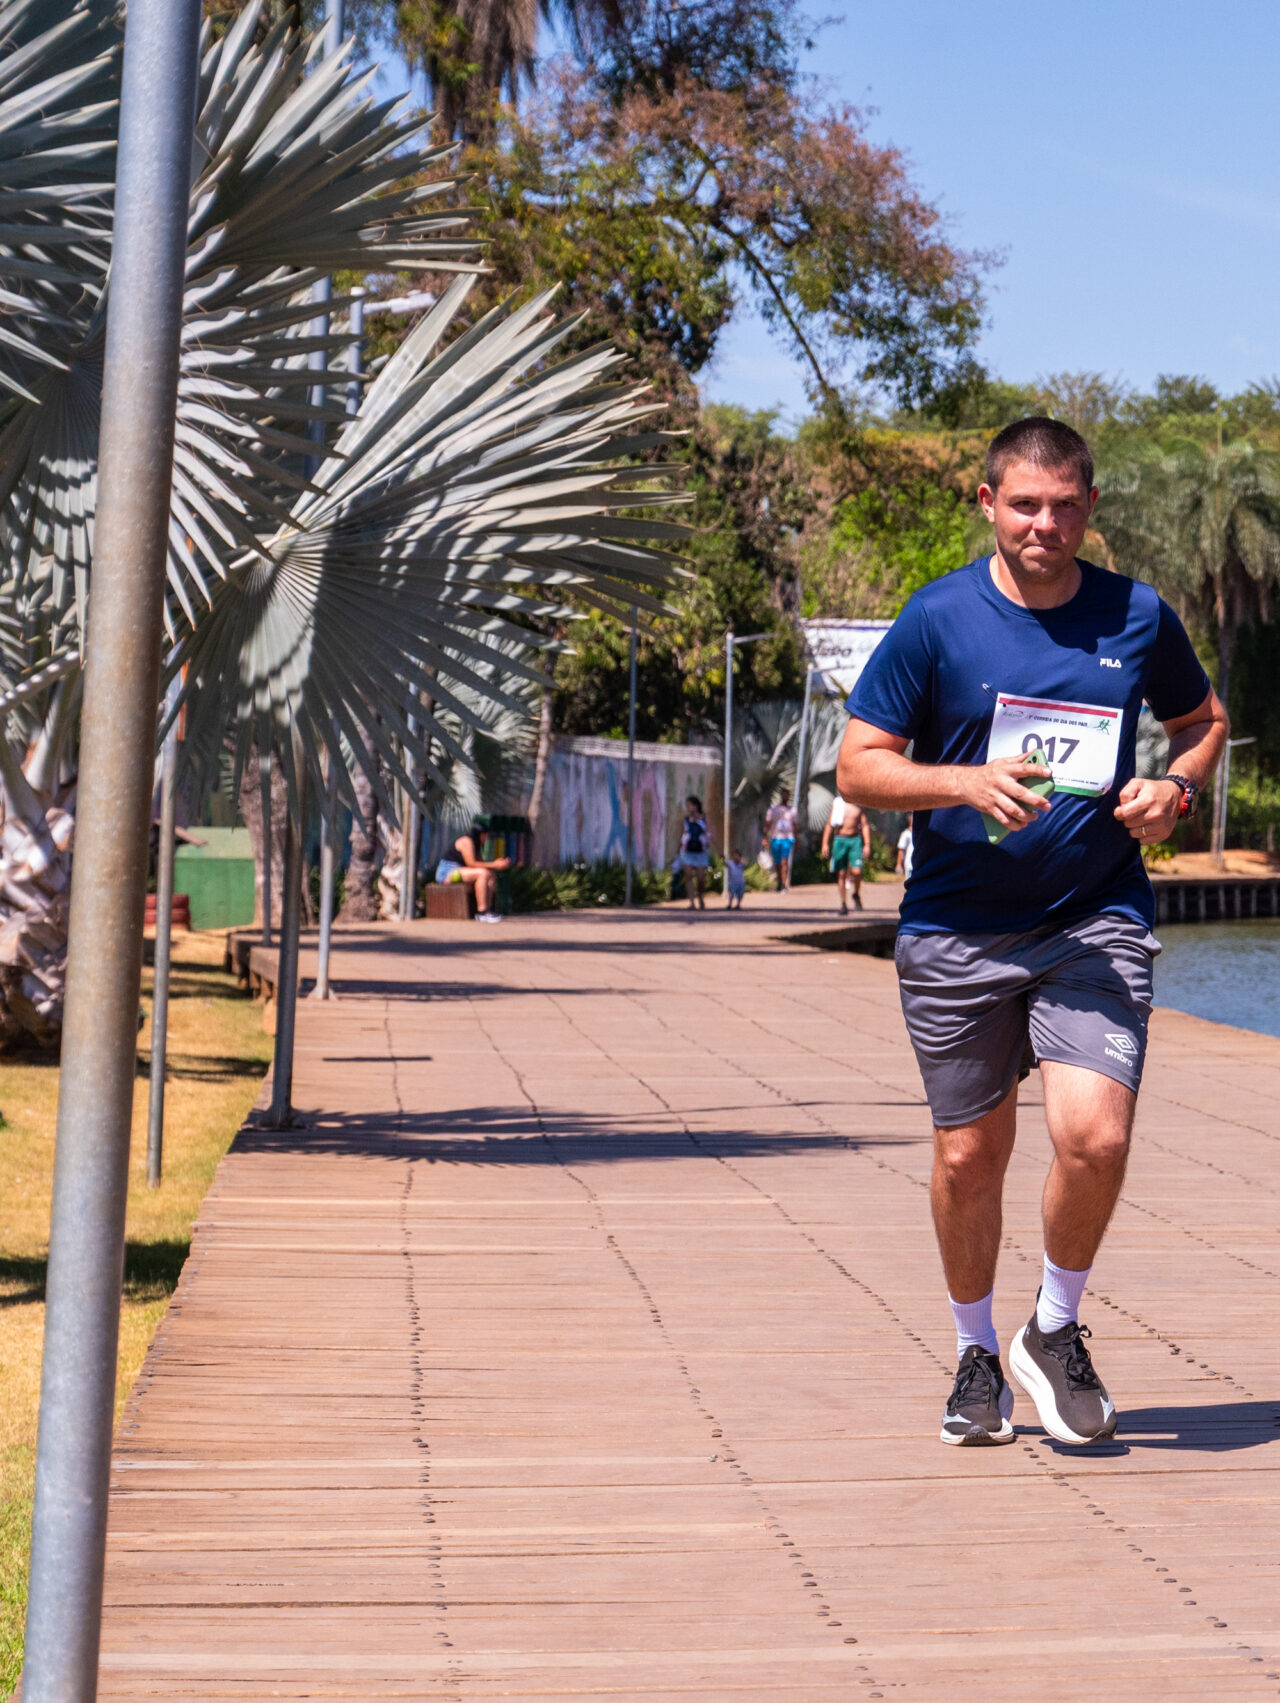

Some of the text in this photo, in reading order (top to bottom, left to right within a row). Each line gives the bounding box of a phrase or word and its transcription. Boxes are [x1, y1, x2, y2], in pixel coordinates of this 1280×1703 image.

[1099, 657, 1122, 669] FILA
[1021, 733, 1080, 764] 017
[1104, 1046, 1133, 1067] umbro
